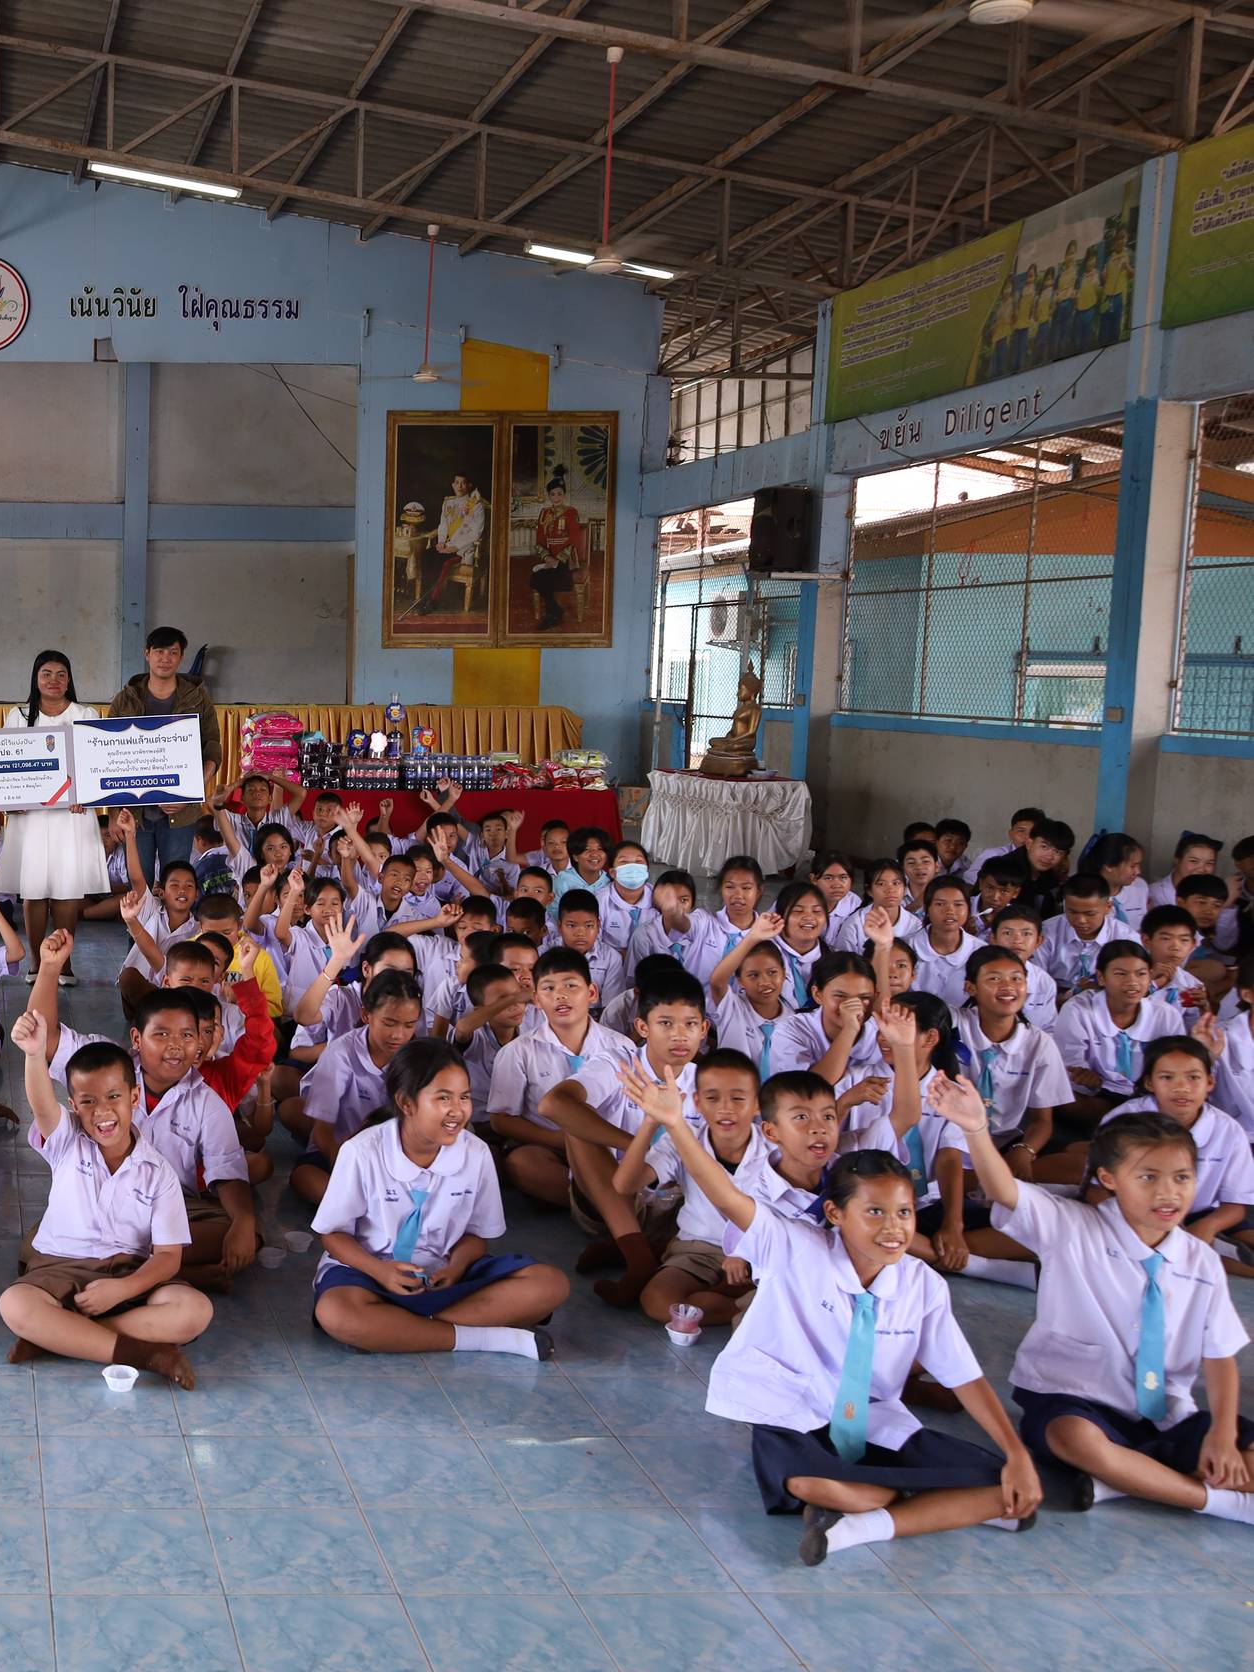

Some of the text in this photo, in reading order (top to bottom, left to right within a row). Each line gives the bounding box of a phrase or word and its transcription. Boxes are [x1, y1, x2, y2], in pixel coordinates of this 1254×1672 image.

[70, 287, 157, 317] เน้นวินัย
[178, 284, 299, 331] ใฝ่คุณธรรม
[880, 408, 922, 450] ขยัน
[945, 388, 1042, 436] Diligent
[15, 748, 24, 756] 61
[105, 777, 176, 787] จำนวน 50,000 บาท
